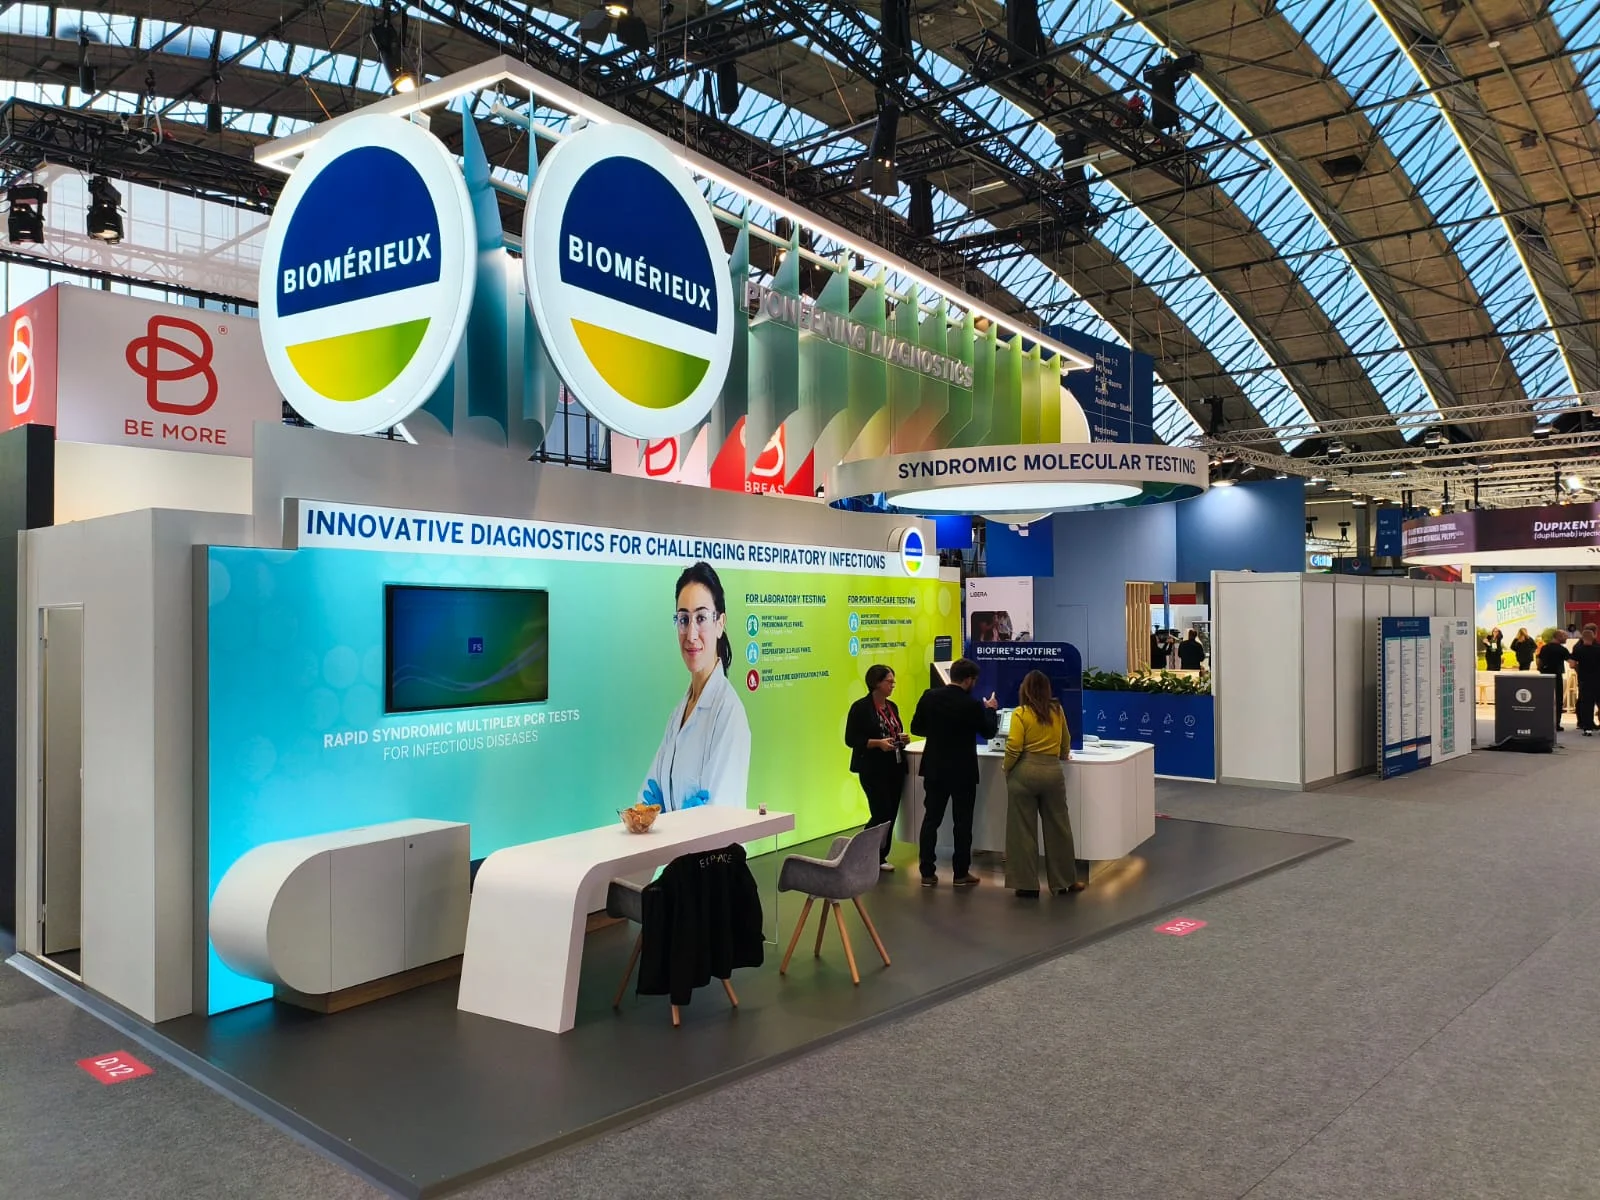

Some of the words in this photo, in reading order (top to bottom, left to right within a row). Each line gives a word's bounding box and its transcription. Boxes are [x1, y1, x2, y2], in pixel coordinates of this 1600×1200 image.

[284, 233, 432, 294] BIOMÉRIEUX
[569, 234, 711, 311] BIOMÉRIEUX
[744, 280, 866, 351] PIONEERING
[870, 330, 973, 388] DIAGNOSTICS
[125, 419, 154, 437] BE
[162, 423, 227, 445] MORE
[898, 455, 1017, 479] SYNDROMIC
[1023, 453, 1141, 471] MOLECULAR
[1145, 454, 1196, 475] TESTING
[306, 509, 464, 544] INNOVATIVE
[470, 523, 604, 552] DIAGNOSTICS
[609, 534, 642, 555] FOR
[646, 537, 745, 561] CHALLENGING
[748, 545, 827, 566] RESPIRATORY
[829, 552, 886, 570] INFECTIONS
[745, 593, 759, 603] FOR
[760, 594, 800, 604] LABORATORY
[802, 594, 826, 604] TESTING
[847, 595, 859, 604] FOR
[859, 596, 895, 604] POINT-OF-CARE
[896, 597, 916, 605] TESTING
[1496, 590, 1537, 611] DUPIXENT
[323, 730, 369, 748] RAPID
[372, 722, 453, 742] SYNDROMIC
[456, 715, 521, 734] MULTIPLEX
[523, 712, 545, 726] PCR
[548, 709, 580, 722] TESTS
[383, 745, 409, 760] FOR
[412, 734, 484, 759] INFECTIOUS
[486, 730, 538, 748] DISEASES
[94, 1056, 135, 1077] D.12
